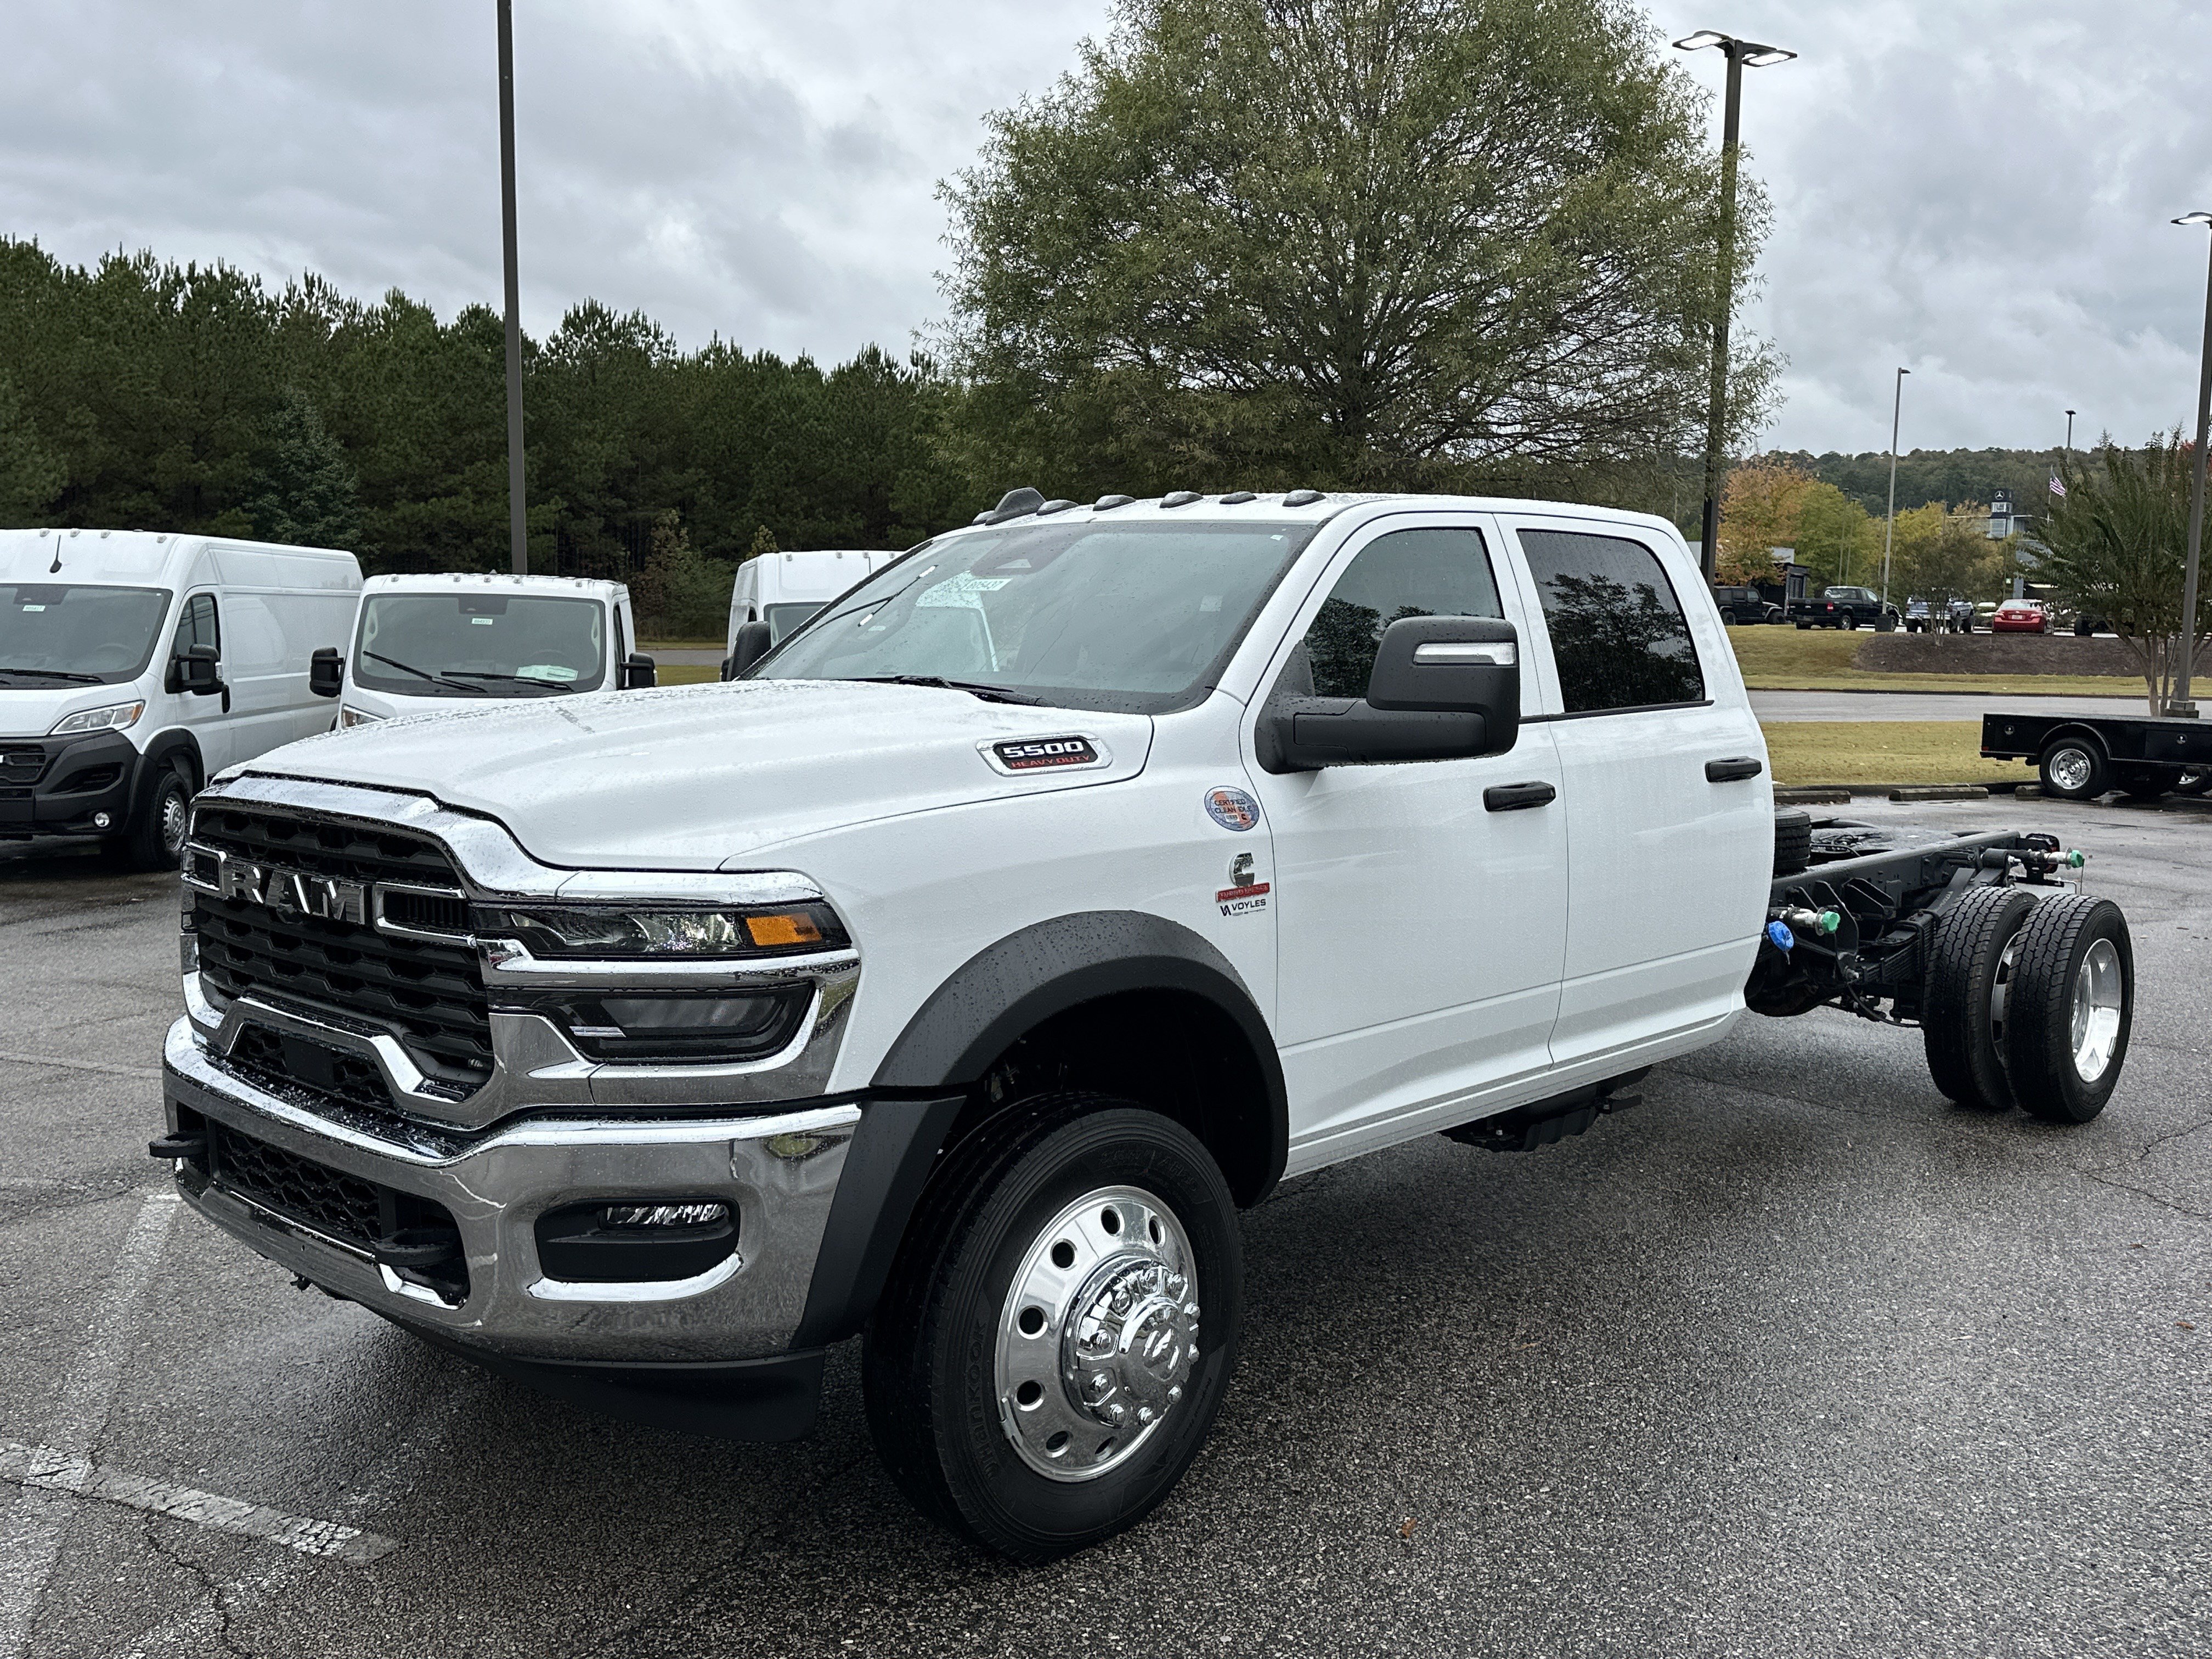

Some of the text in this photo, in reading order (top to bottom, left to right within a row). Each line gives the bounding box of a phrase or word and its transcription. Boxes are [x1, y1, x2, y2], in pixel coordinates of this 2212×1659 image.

[1003, 741, 1084, 758] 5500
[1011, 755, 1090, 768] HEAVY DUTY
[221, 862, 365, 925] RAM
[1232, 899, 1266, 911] VOYLES
